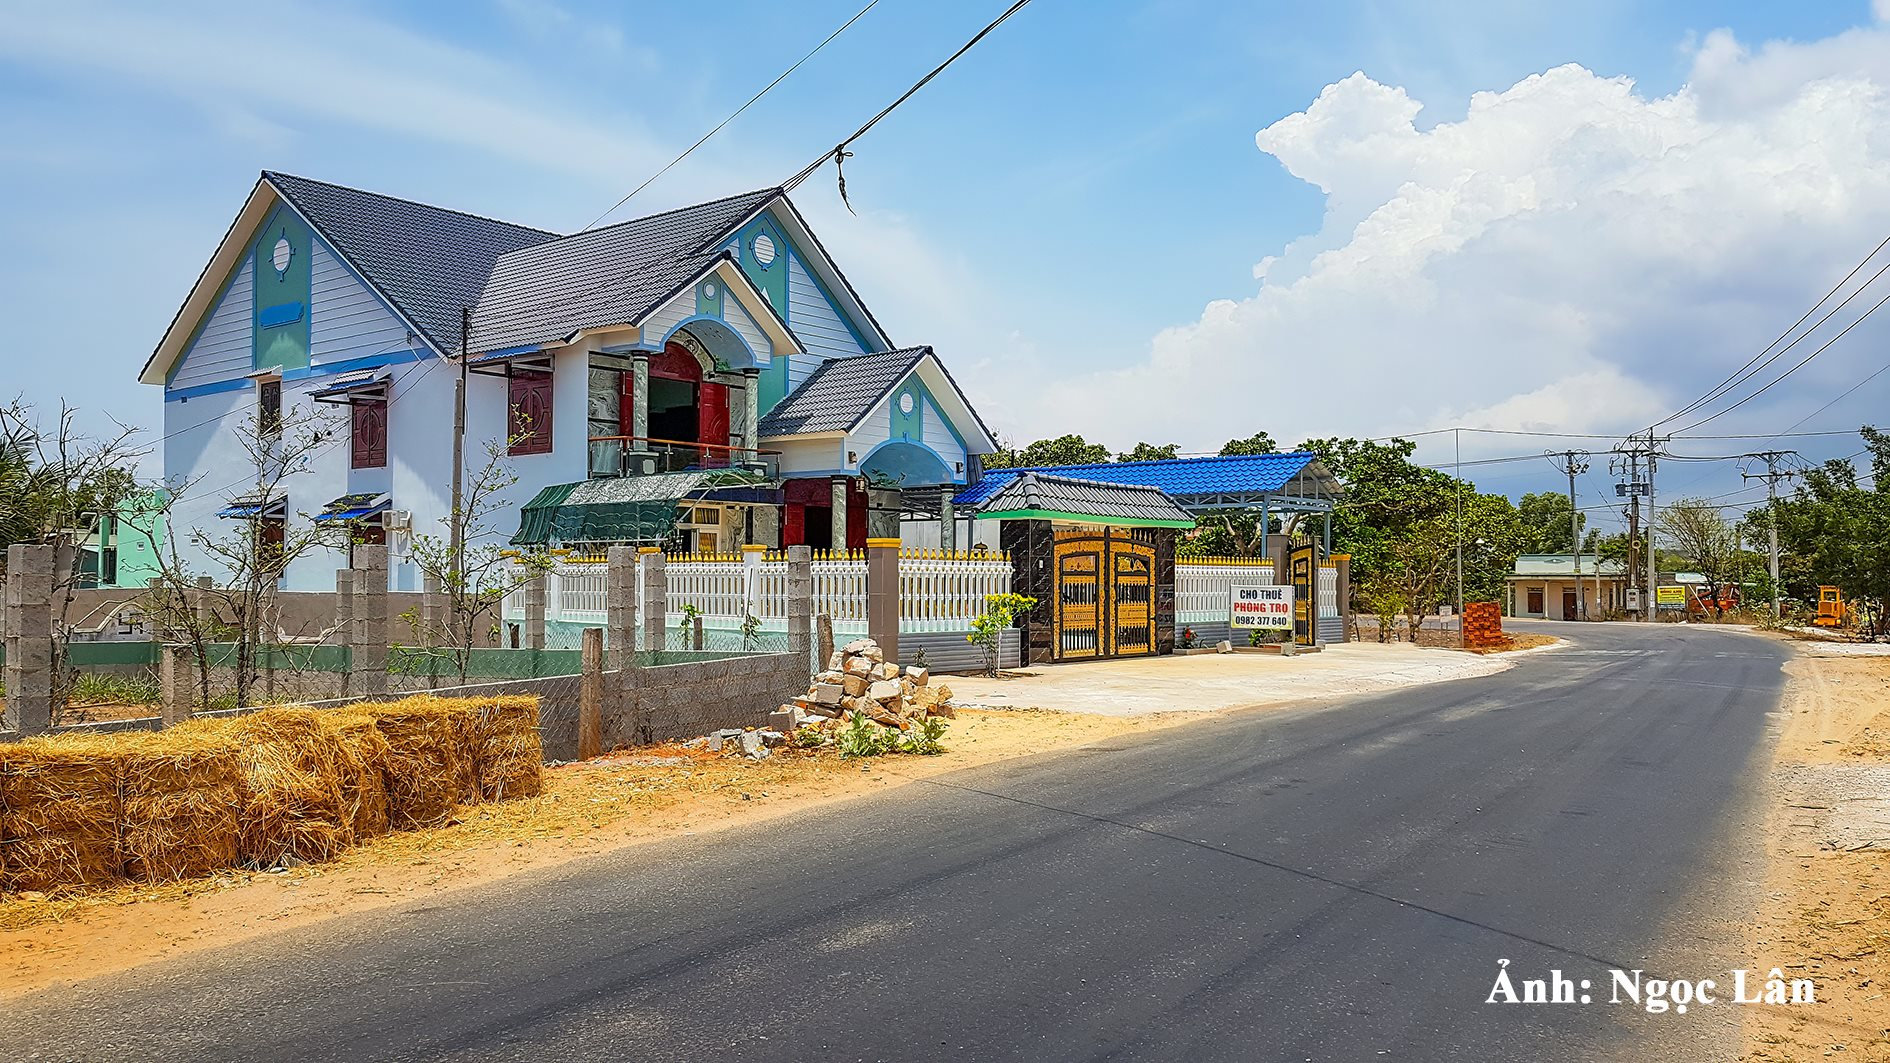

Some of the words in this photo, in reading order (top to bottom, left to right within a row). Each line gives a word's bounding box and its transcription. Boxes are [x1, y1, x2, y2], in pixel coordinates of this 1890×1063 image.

[1240, 589, 1258, 600] CHO
[1260, 588, 1282, 600] THUÊ
[1234, 601, 1267, 613] PHÒNG
[1269, 603, 1288, 615] TRỌ
[1235, 616, 1255, 625] 0982
[1257, 616, 1270, 625] 377
[1271, 616, 1287, 626] 640
